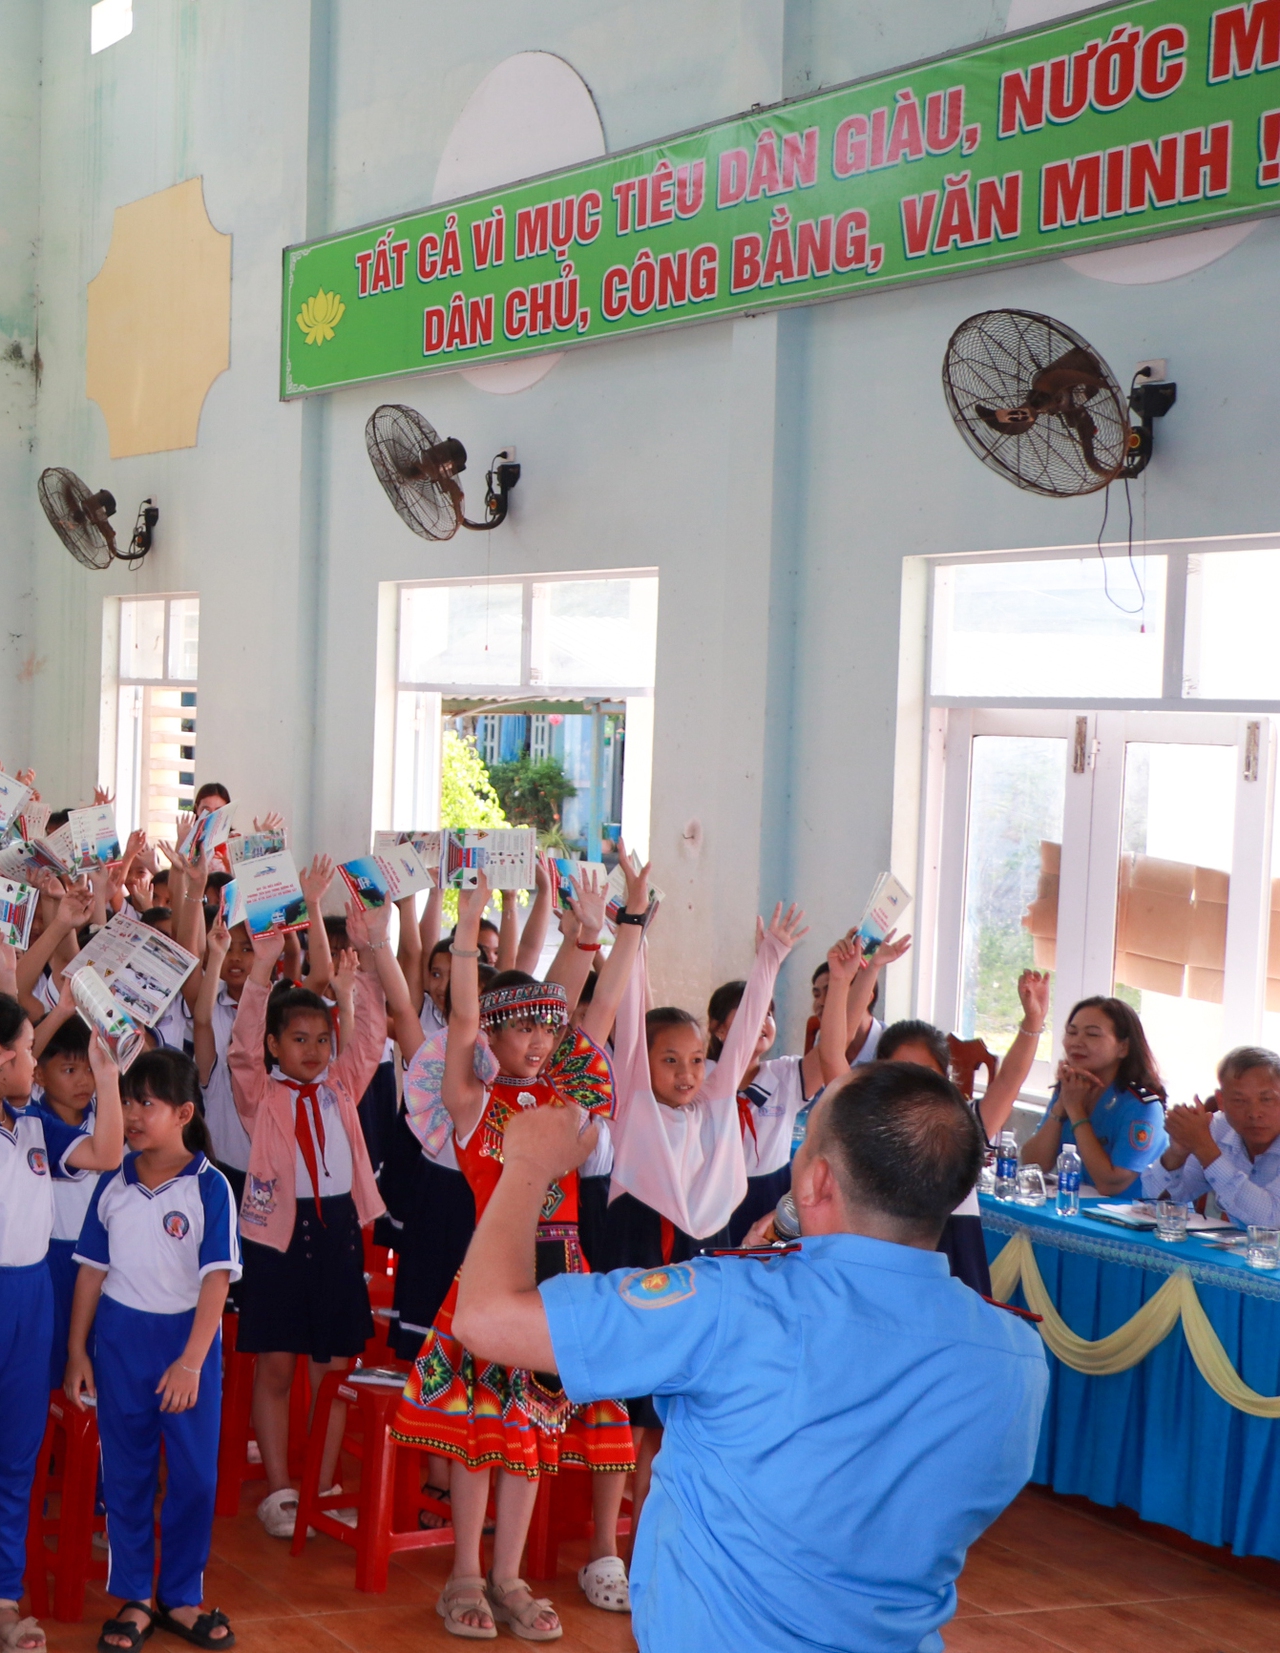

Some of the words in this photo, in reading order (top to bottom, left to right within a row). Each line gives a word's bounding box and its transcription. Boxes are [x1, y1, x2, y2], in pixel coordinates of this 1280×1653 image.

[355, 229, 410, 296] TẤT
[417, 213, 464, 281] CẢ
[471, 206, 506, 269] VÌ
[515, 190, 603, 260] MỤC
[612, 159, 706, 233] TIÊU
[718, 128, 819, 207] DÂN
[833, 87, 981, 176] GIÀU,
[1000, 25, 1187, 135] NƯỚC
[423, 292, 495, 354] DÂN
[504, 261, 591, 339] CHỦ,
[602, 244, 719, 319] CÔNG
[731, 205, 885, 292] BẰNG,
[901, 172, 1022, 256] VĂN
[1041, 122, 1232, 228] MINH
